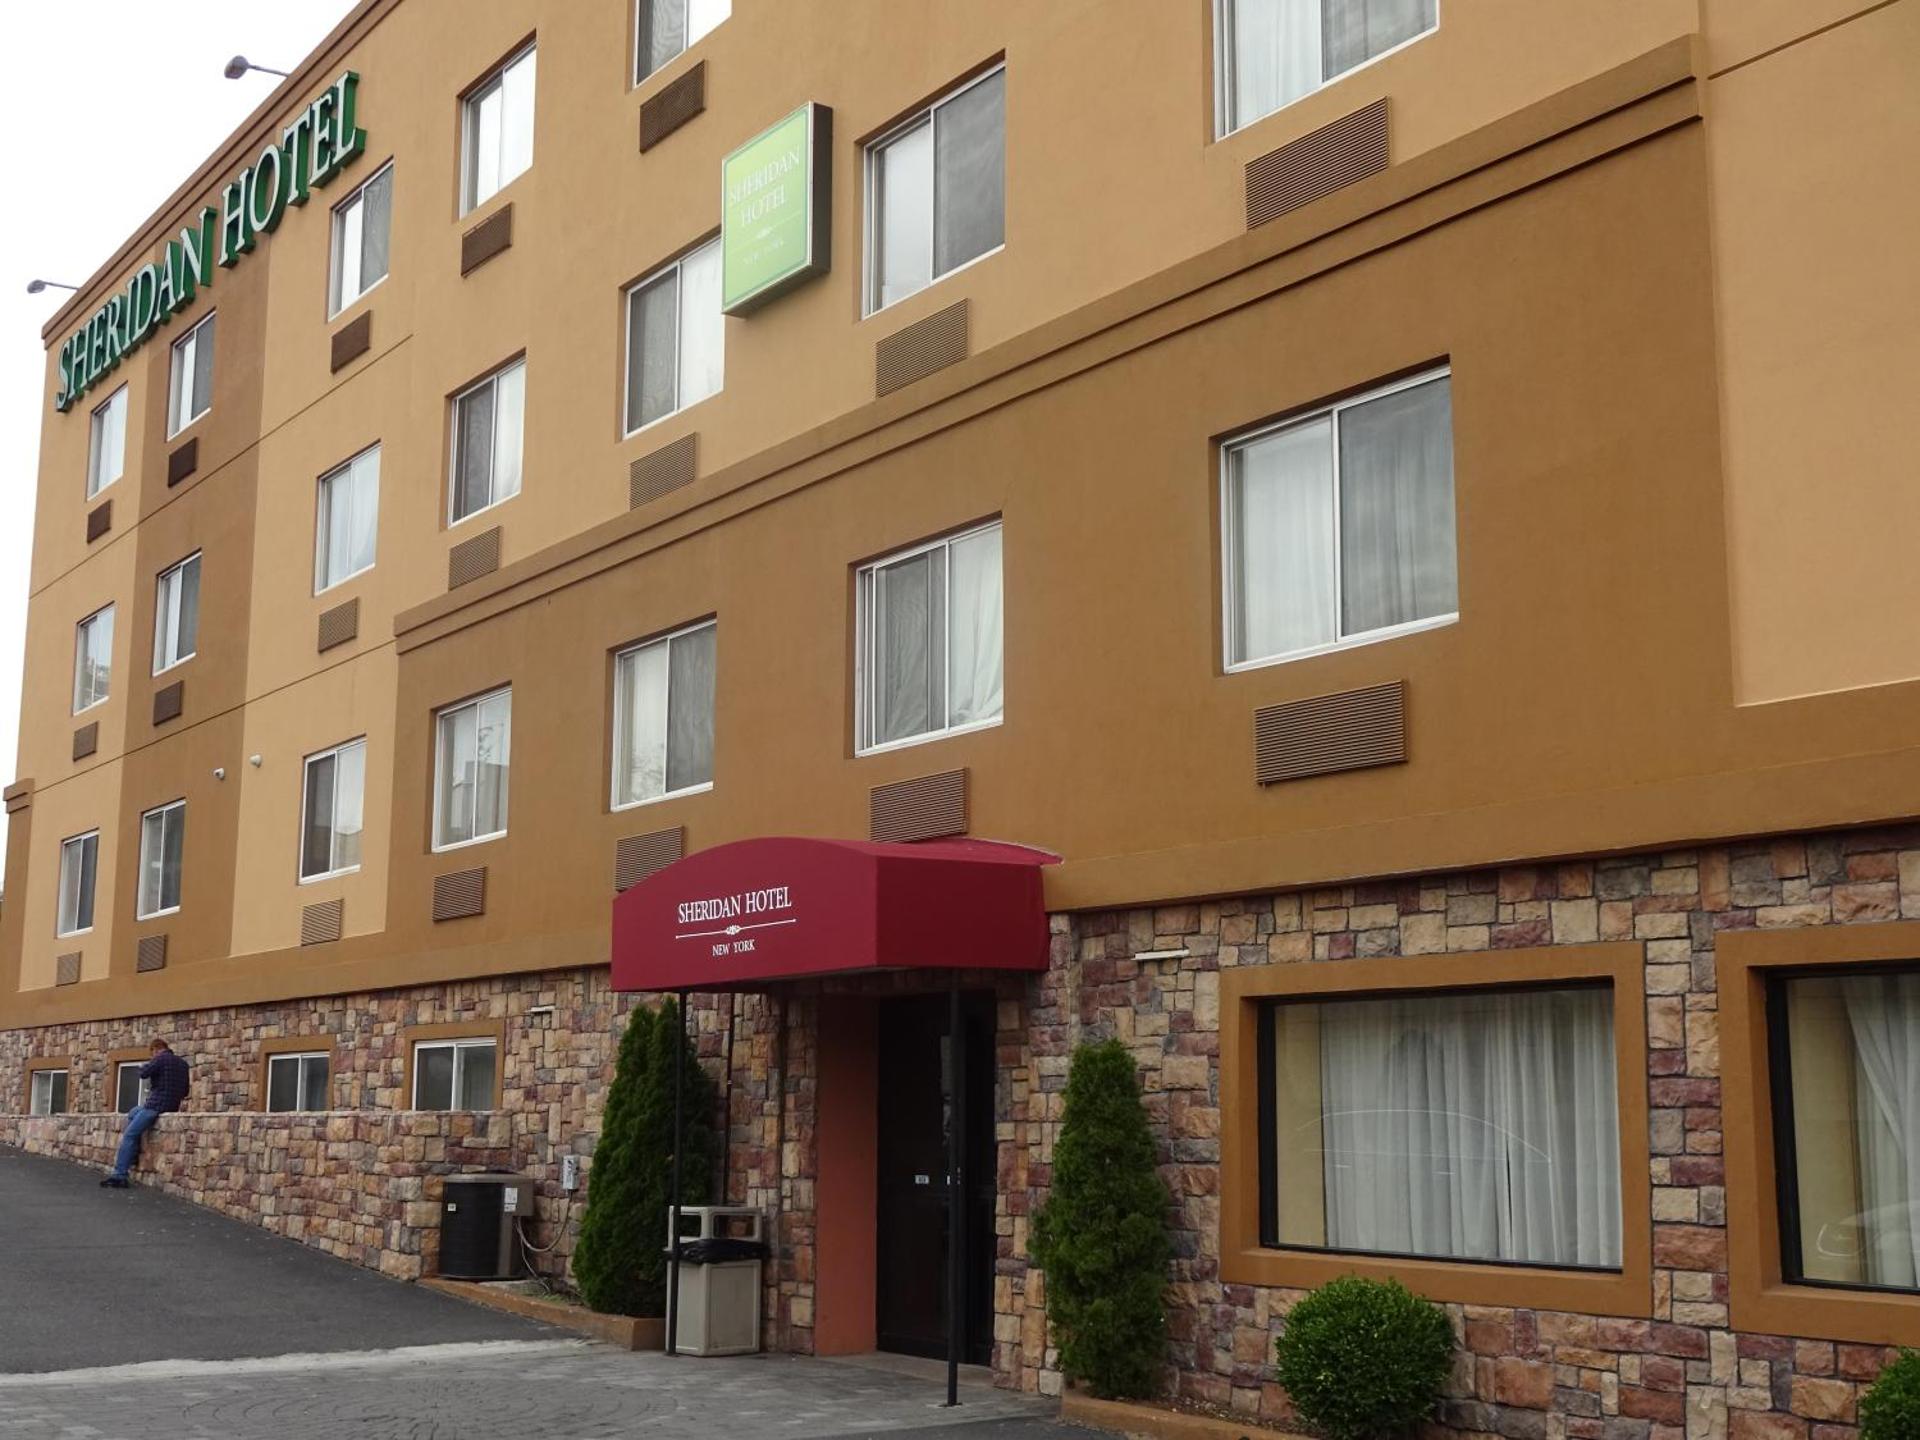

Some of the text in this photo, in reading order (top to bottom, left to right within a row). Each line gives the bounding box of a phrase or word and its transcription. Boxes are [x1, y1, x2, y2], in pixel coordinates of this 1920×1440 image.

[729, 145, 801, 204] SHERIDAN
[740, 184, 786, 227] HOTEL
[56, 70, 368, 413] SHERIDAN HOTEL
[678, 886, 792, 924] SHERIDAN HOTEL
[712, 938, 755, 956] NEW YORK
